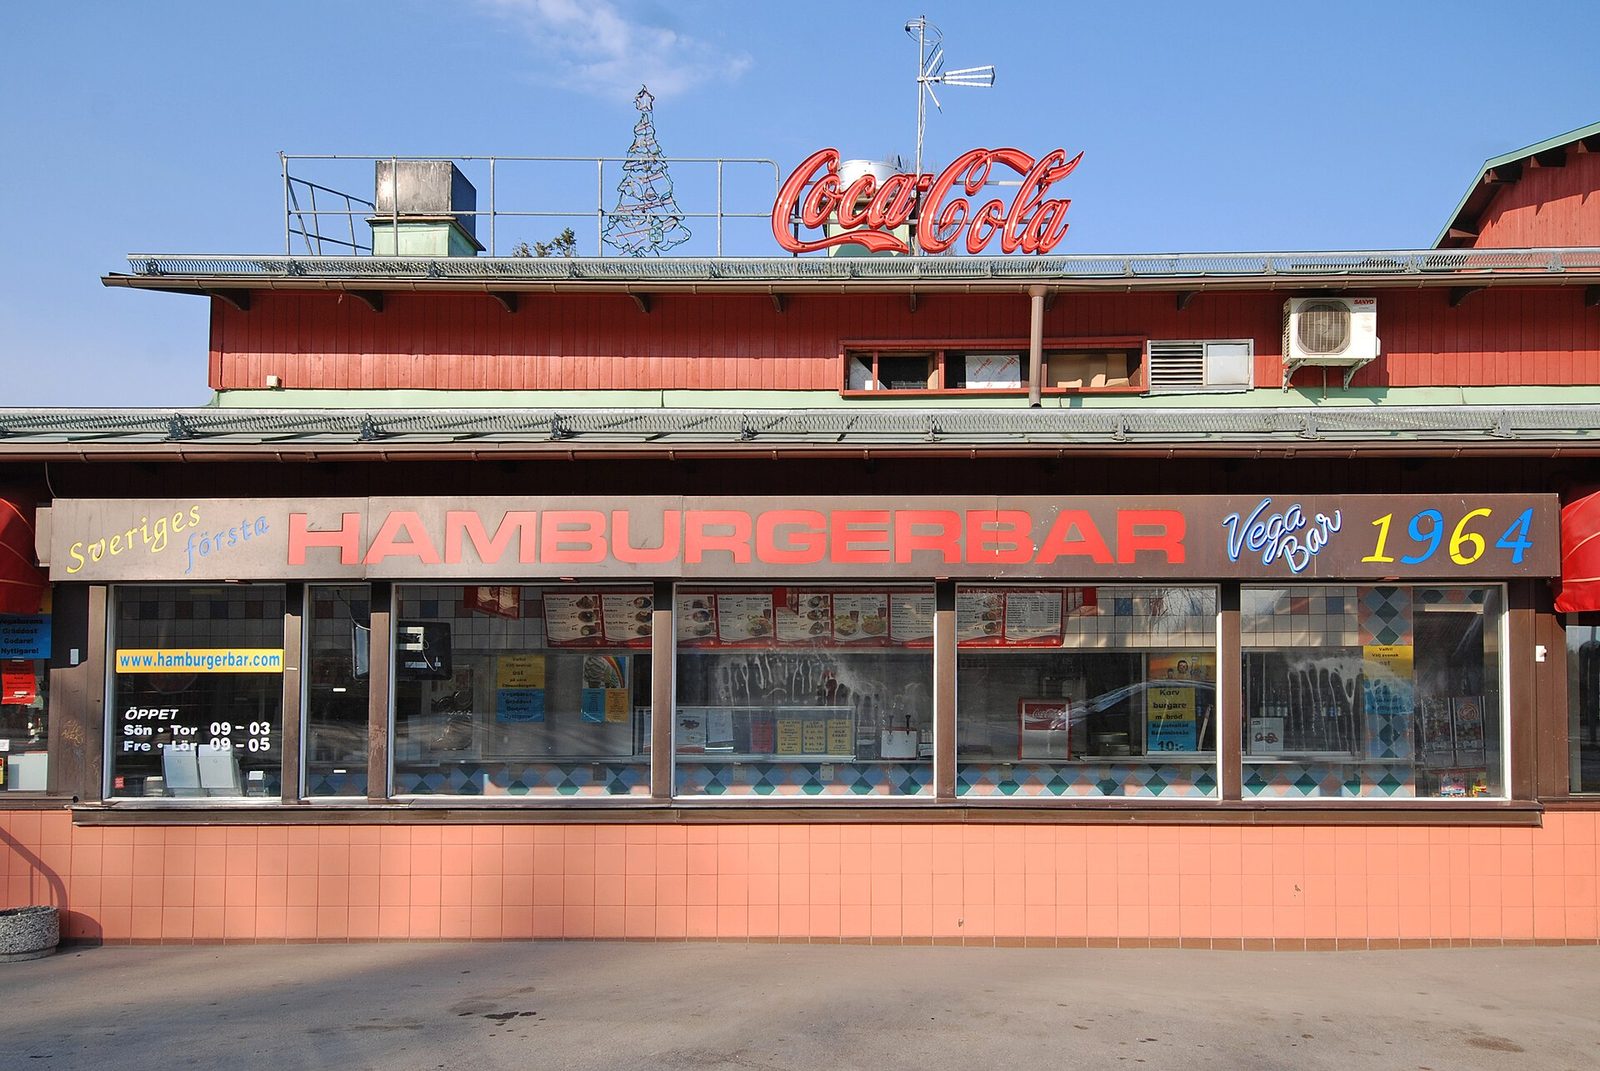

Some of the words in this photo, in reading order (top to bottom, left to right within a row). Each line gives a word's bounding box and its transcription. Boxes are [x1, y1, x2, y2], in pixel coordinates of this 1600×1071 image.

[66, 504, 201, 575] Sveriges
[184, 514, 270, 575] första
[288, 509, 1186, 565] HAMBURGERBAR
[1221, 497, 1306, 567] Vega
[1276, 508, 1342, 575] Bar
[1360, 507, 1534, 566] 1964
[119, 651, 280, 670] www.hamburgerbar.com
[124, 707, 179, 720] ÖPPET
[124, 724, 152, 736] Sön
[170, 724, 198, 736] Tor
[210, 721, 231, 736] 09
[249, 721, 271, 736] 03
[1153, 702, 1187, 710] burgare
[124, 740, 151, 752] Fre
[171, 740, 198, 752] Lör
[210, 737, 231, 751] 09
[248, 737, 271, 752] 05
